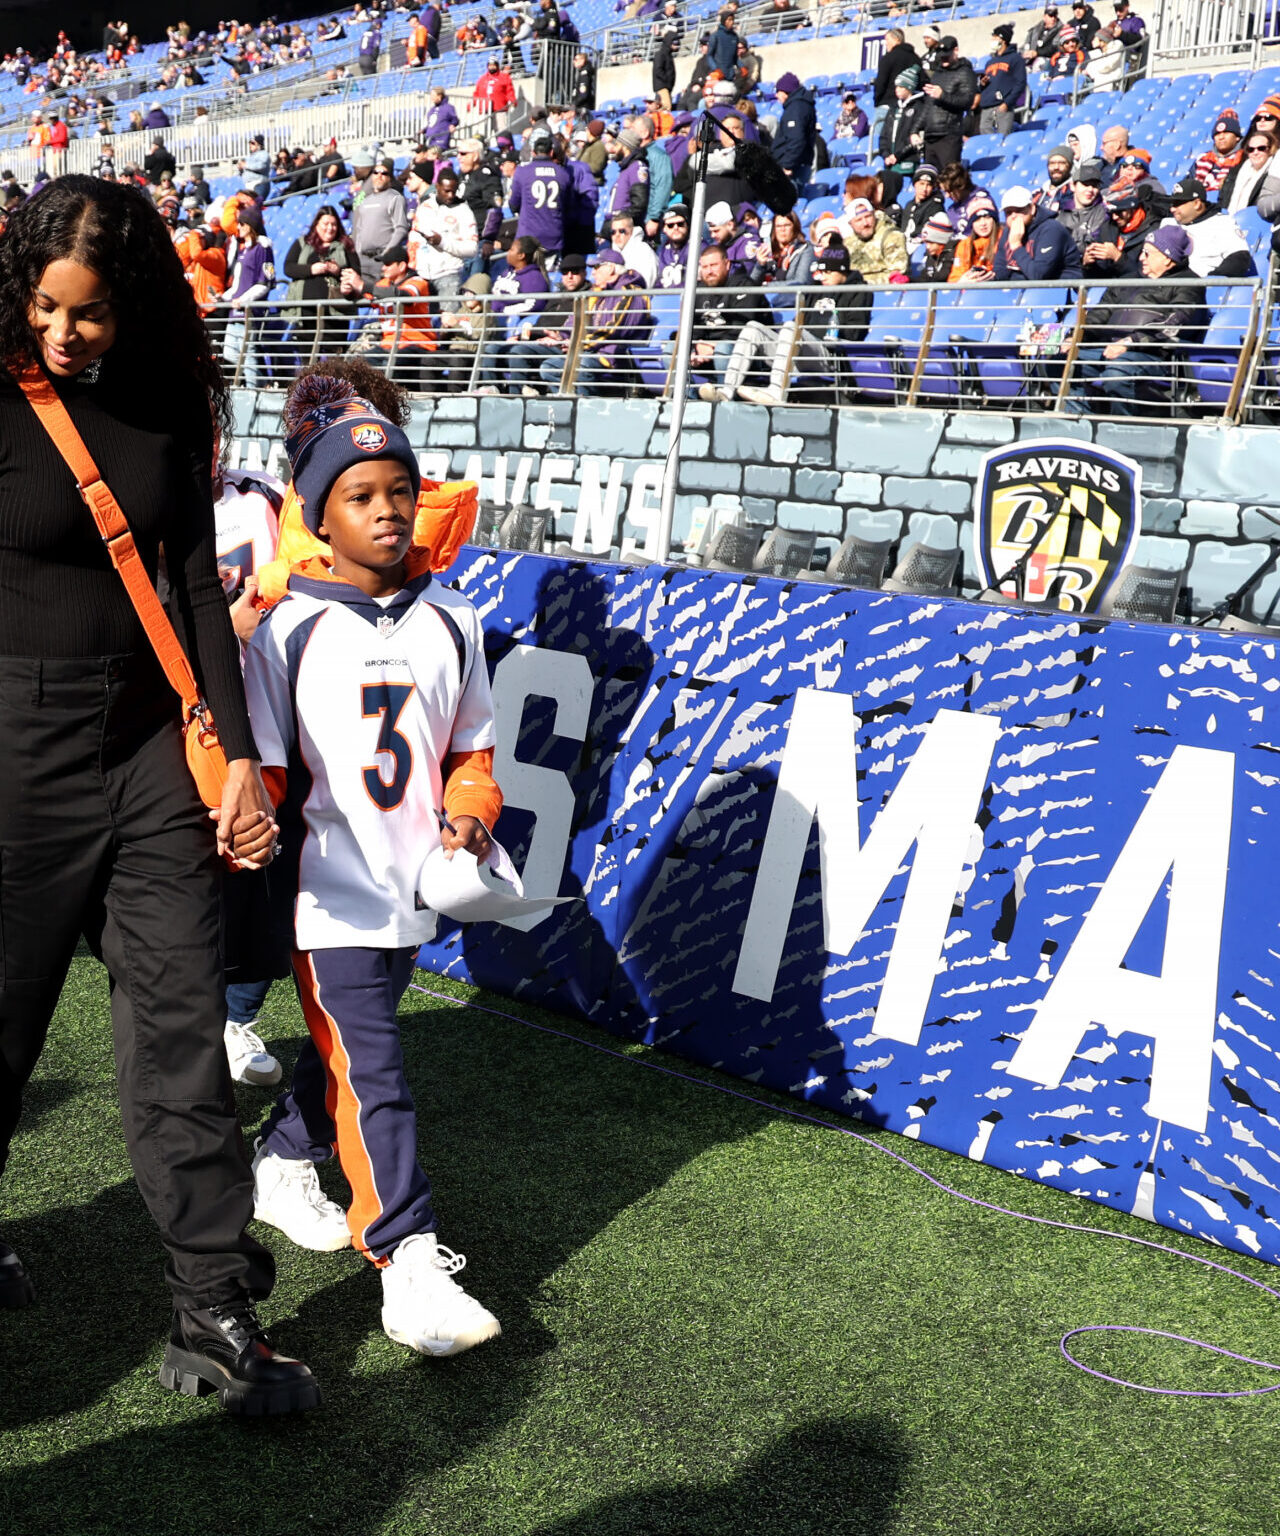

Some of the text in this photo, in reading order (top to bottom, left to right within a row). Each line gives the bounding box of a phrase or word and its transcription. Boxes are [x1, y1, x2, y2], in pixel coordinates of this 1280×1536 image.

[531, 180, 560, 209] 92
[996, 457, 1121, 492] RAVENS
[365, 659, 408, 668] BRONCOS
[360, 681, 416, 812] 3
